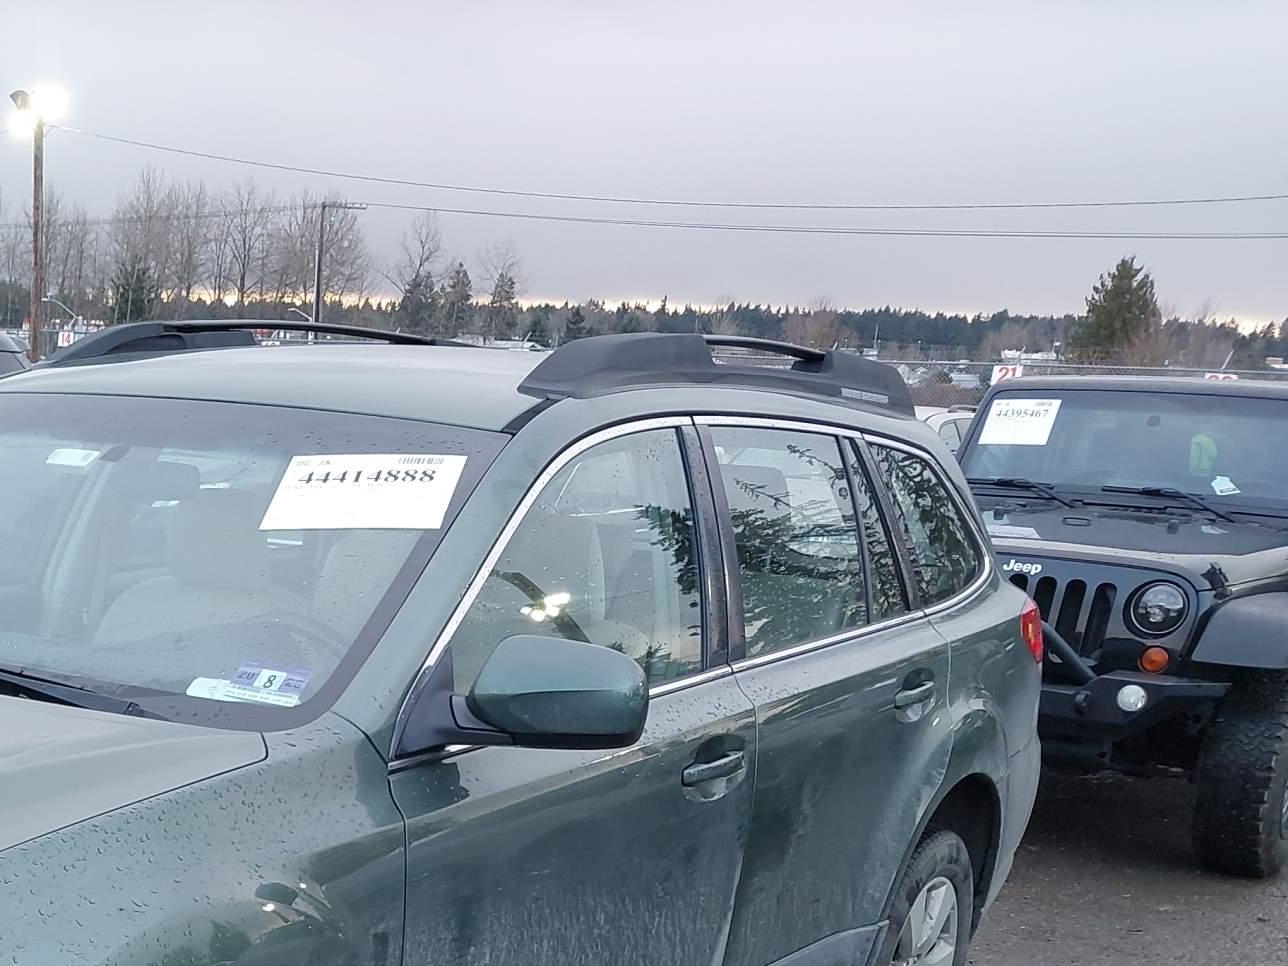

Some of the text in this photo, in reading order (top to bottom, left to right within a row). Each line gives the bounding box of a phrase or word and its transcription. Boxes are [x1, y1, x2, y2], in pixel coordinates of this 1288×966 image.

[297, 468, 437, 484] 44414888
[1002, 559, 1042, 576] Jeep
[263, 674, 277, 688] 8
